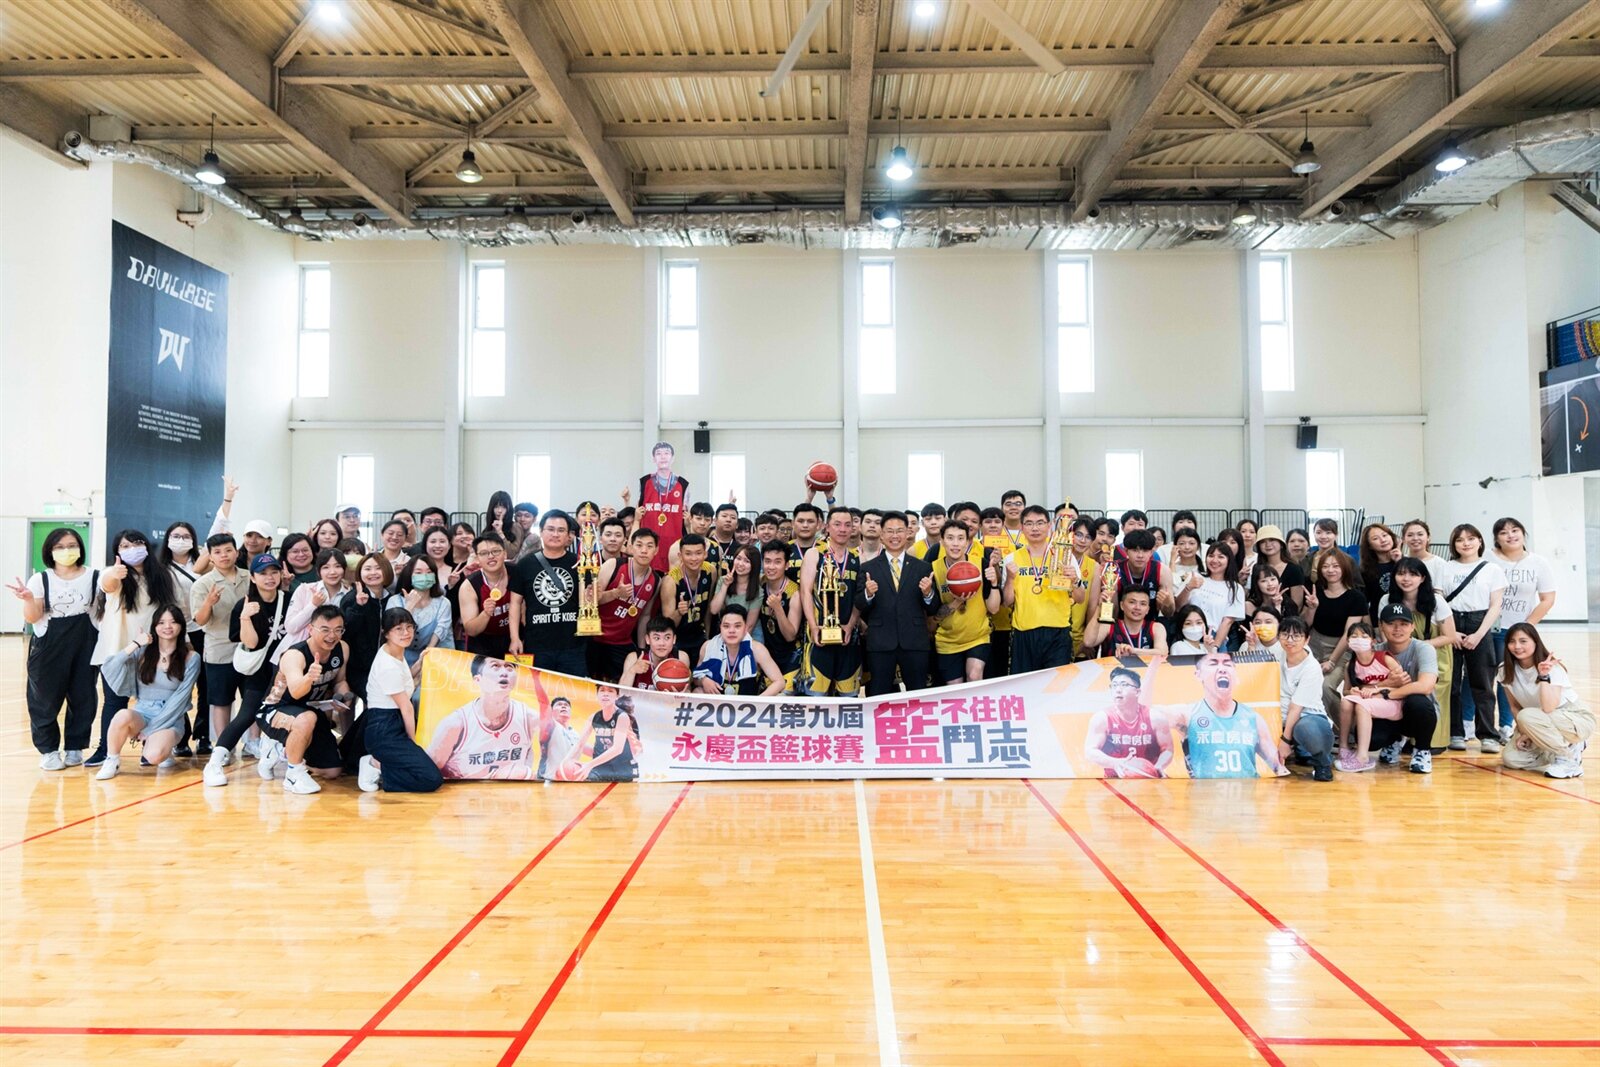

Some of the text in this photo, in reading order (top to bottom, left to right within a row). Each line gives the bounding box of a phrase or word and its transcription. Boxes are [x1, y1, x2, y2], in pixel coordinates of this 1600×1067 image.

[127, 255, 216, 312] DAVILLAGE
[532, 612, 577, 624] SPIRIT OF KOBE
[614, 605, 628, 619] 58
[673, 702, 864, 729] #2024第九屆
[941, 695, 1025, 724] 不住的
[671, 731, 864, 764] 永慶盃籃球賽
[1214, 749, 1242, 773] 30
